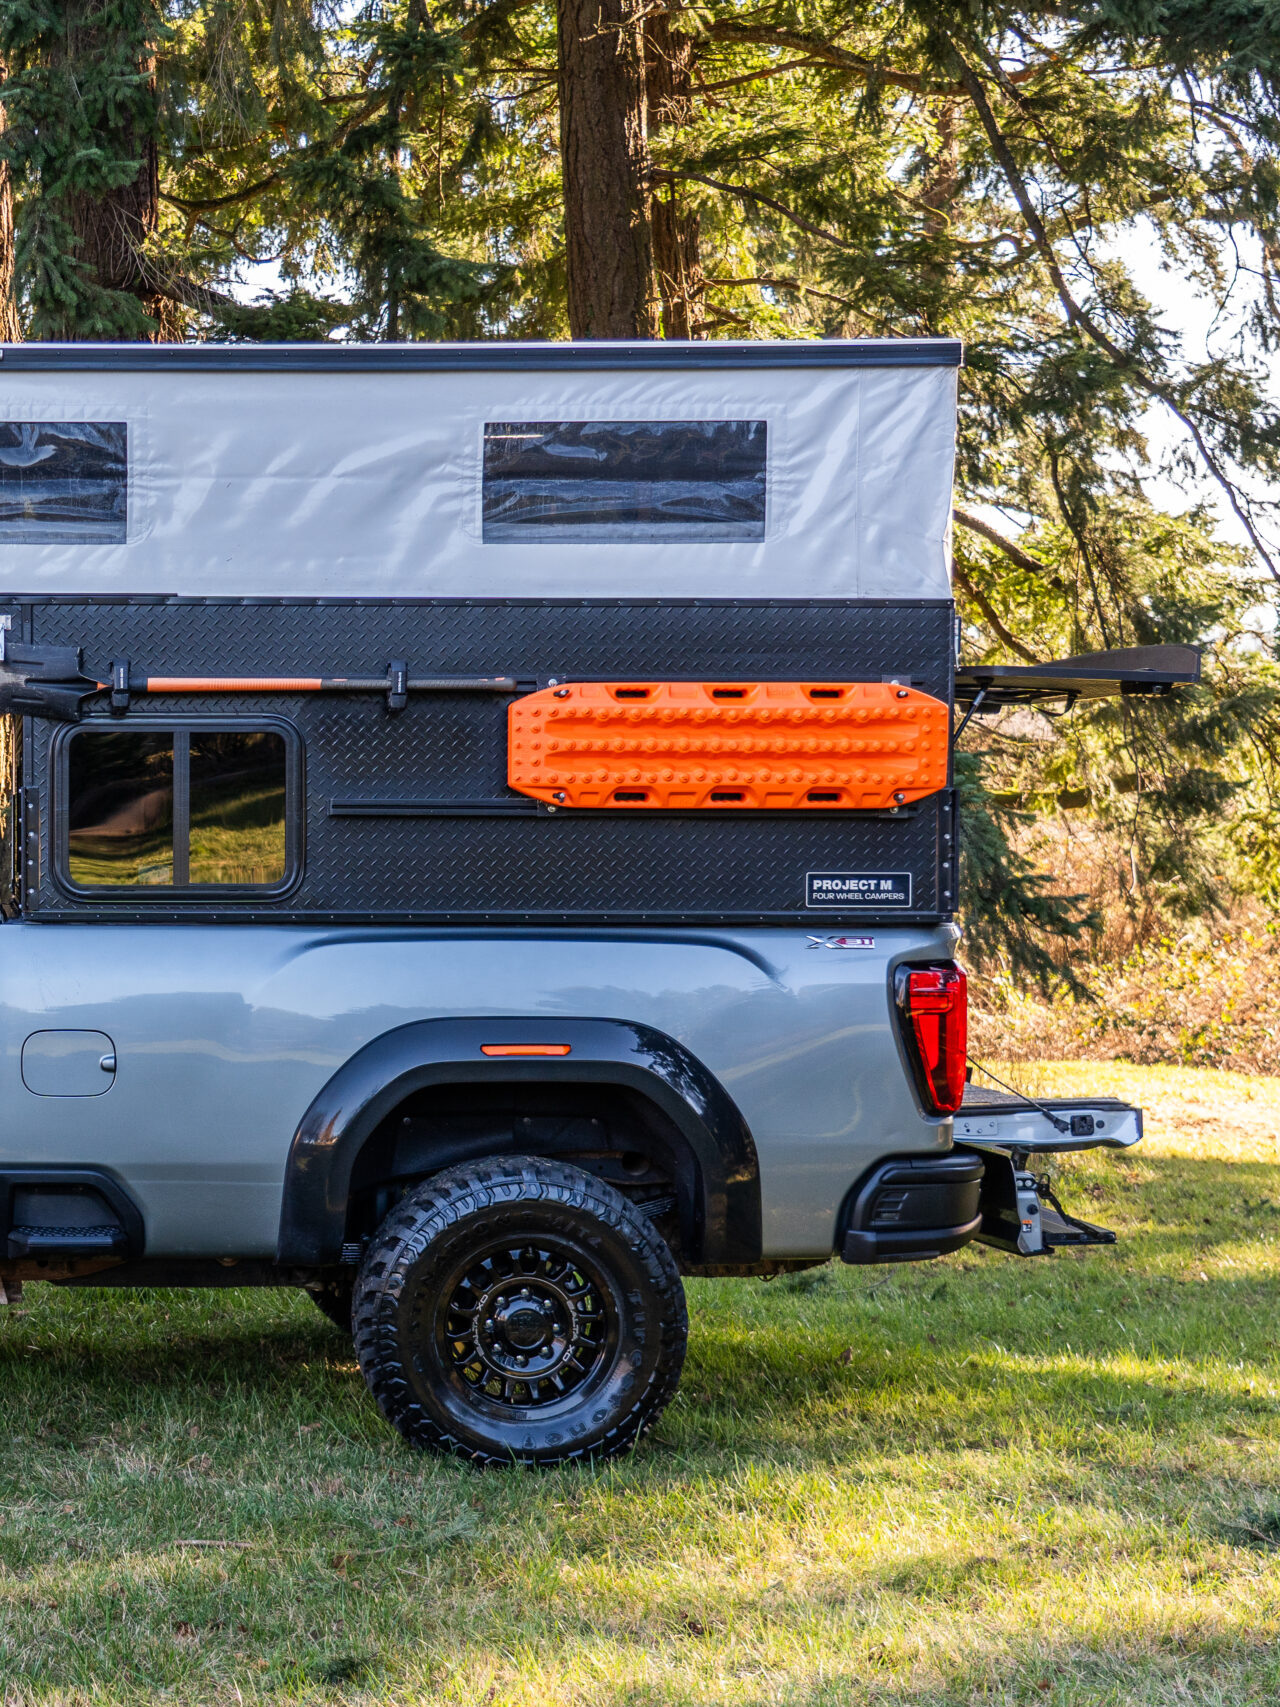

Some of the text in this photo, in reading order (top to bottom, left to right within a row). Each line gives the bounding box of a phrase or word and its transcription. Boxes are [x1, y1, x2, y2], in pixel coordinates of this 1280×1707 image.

[812, 879, 893, 891] PROJECT M
[812, 892, 905, 900] FOUR WHEEL CAMPERS
